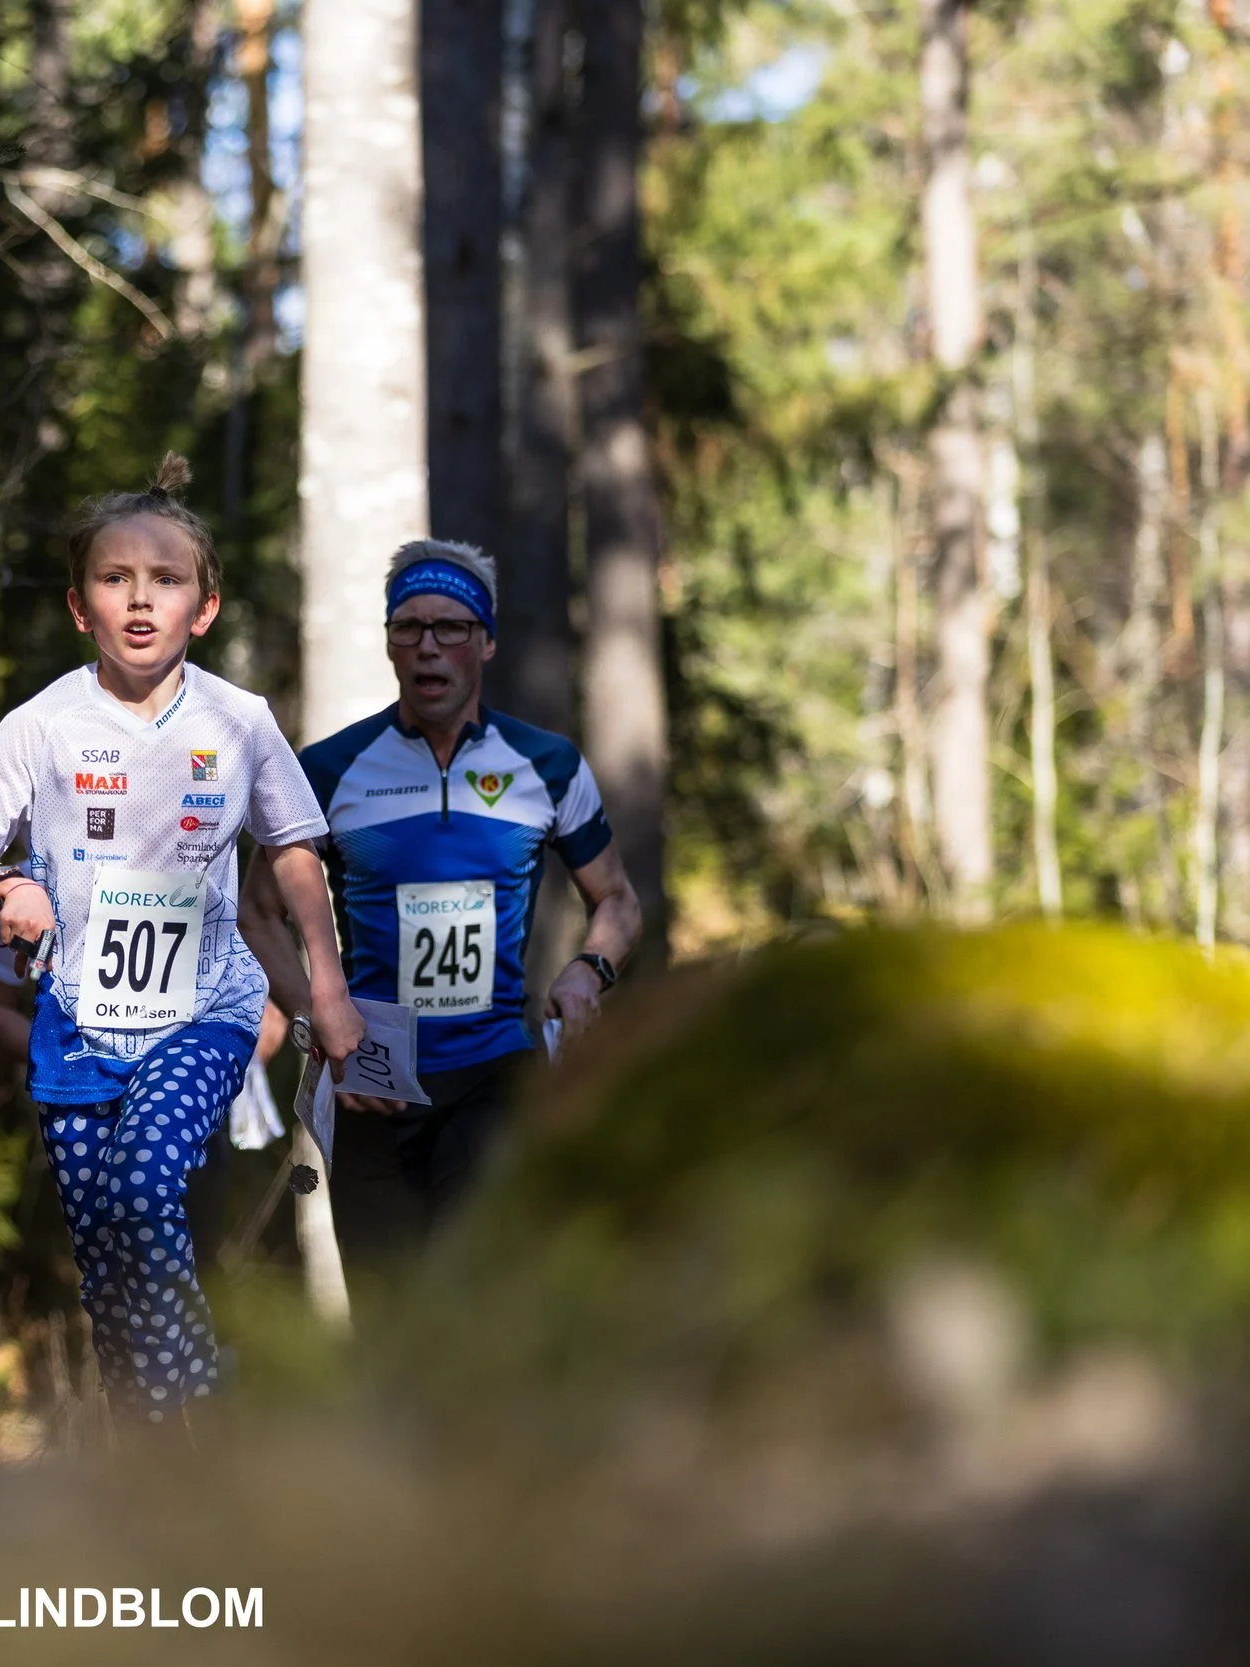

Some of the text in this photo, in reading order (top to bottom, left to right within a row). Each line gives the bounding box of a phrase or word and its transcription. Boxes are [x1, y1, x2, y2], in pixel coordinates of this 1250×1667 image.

[155, 687, 187, 729] noname
[81, 750, 120, 763] SSAB
[75, 773, 127, 790] MAXI
[365, 784, 429, 798] noname
[89, 810, 107, 819] PER
[176, 841, 221, 852] Sörmlands
[100, 890, 168, 908] NOREX
[405, 900, 462, 916] NOREX
[98, 919, 188, 994] 507
[413, 924, 482, 988] 245
[413, 995, 480, 1009] OK Måsen
[95, 1003, 177, 1019] OK Måsen
[357, 1036, 397, 1091] 507
